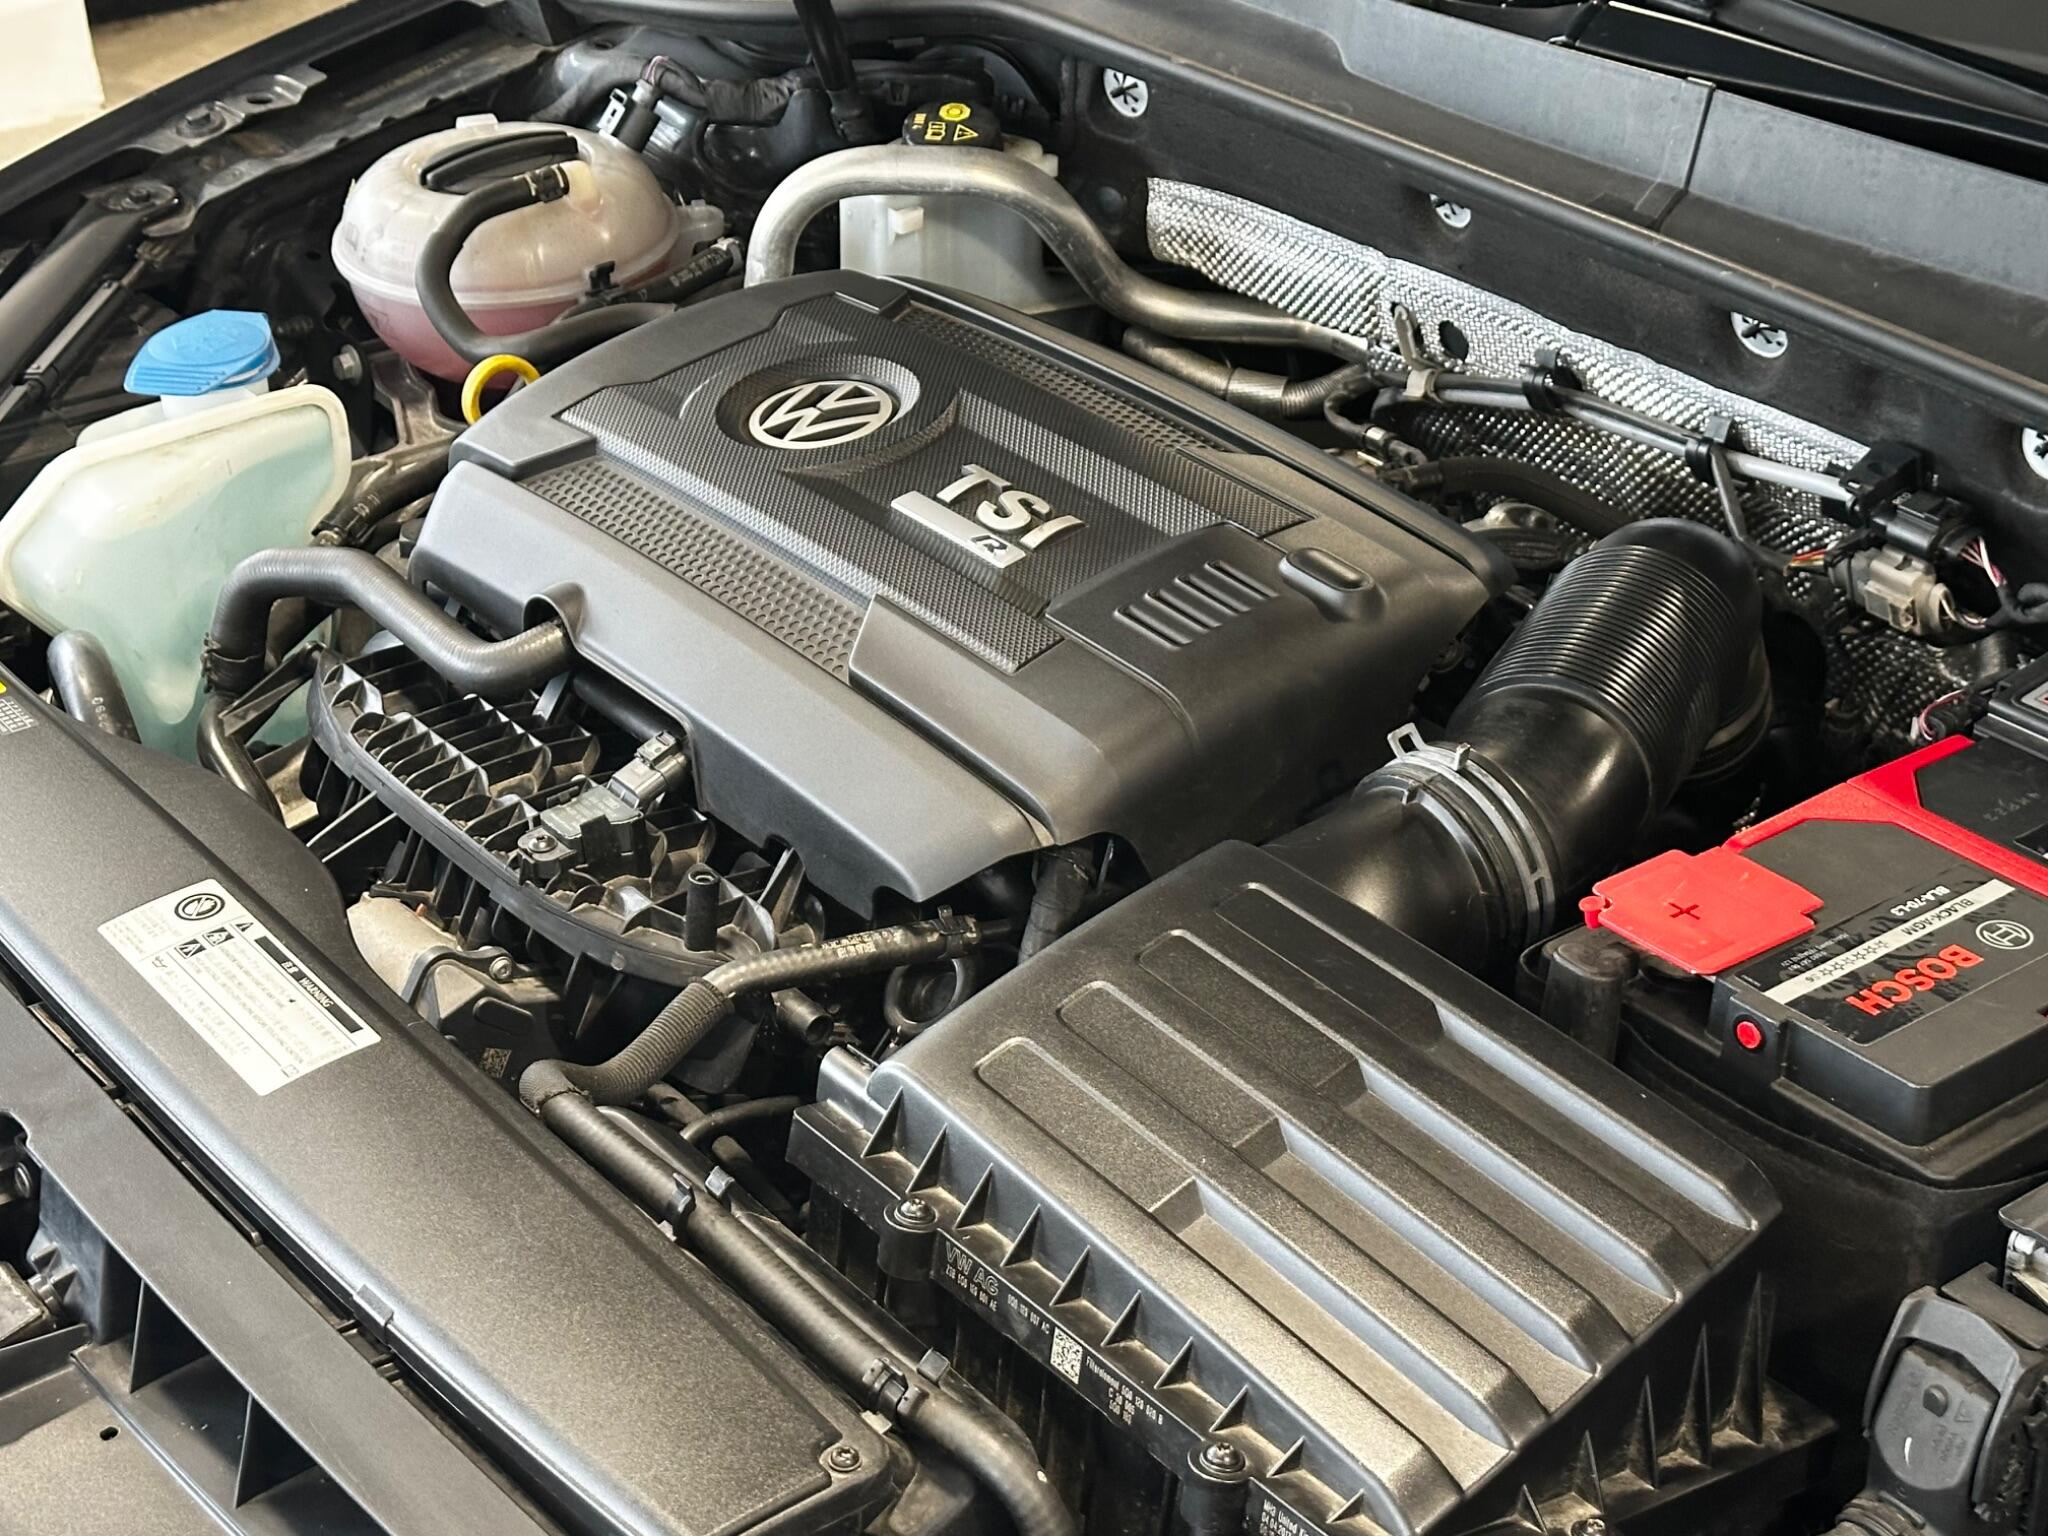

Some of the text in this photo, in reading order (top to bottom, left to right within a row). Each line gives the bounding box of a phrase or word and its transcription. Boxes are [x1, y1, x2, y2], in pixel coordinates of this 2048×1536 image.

[936, 463, 1086, 550] TSI
[970, 534, 1007, 555] R
[1890, 885, 1951, 916] BLA-70-L3
[1901, 898, 1975, 936] BLACK-AGM
[299, 976, 334, 1008] WARNING
[1845, 943, 1984, 1017] BOSCH
[945, 1240, 999, 1296] VW AG
